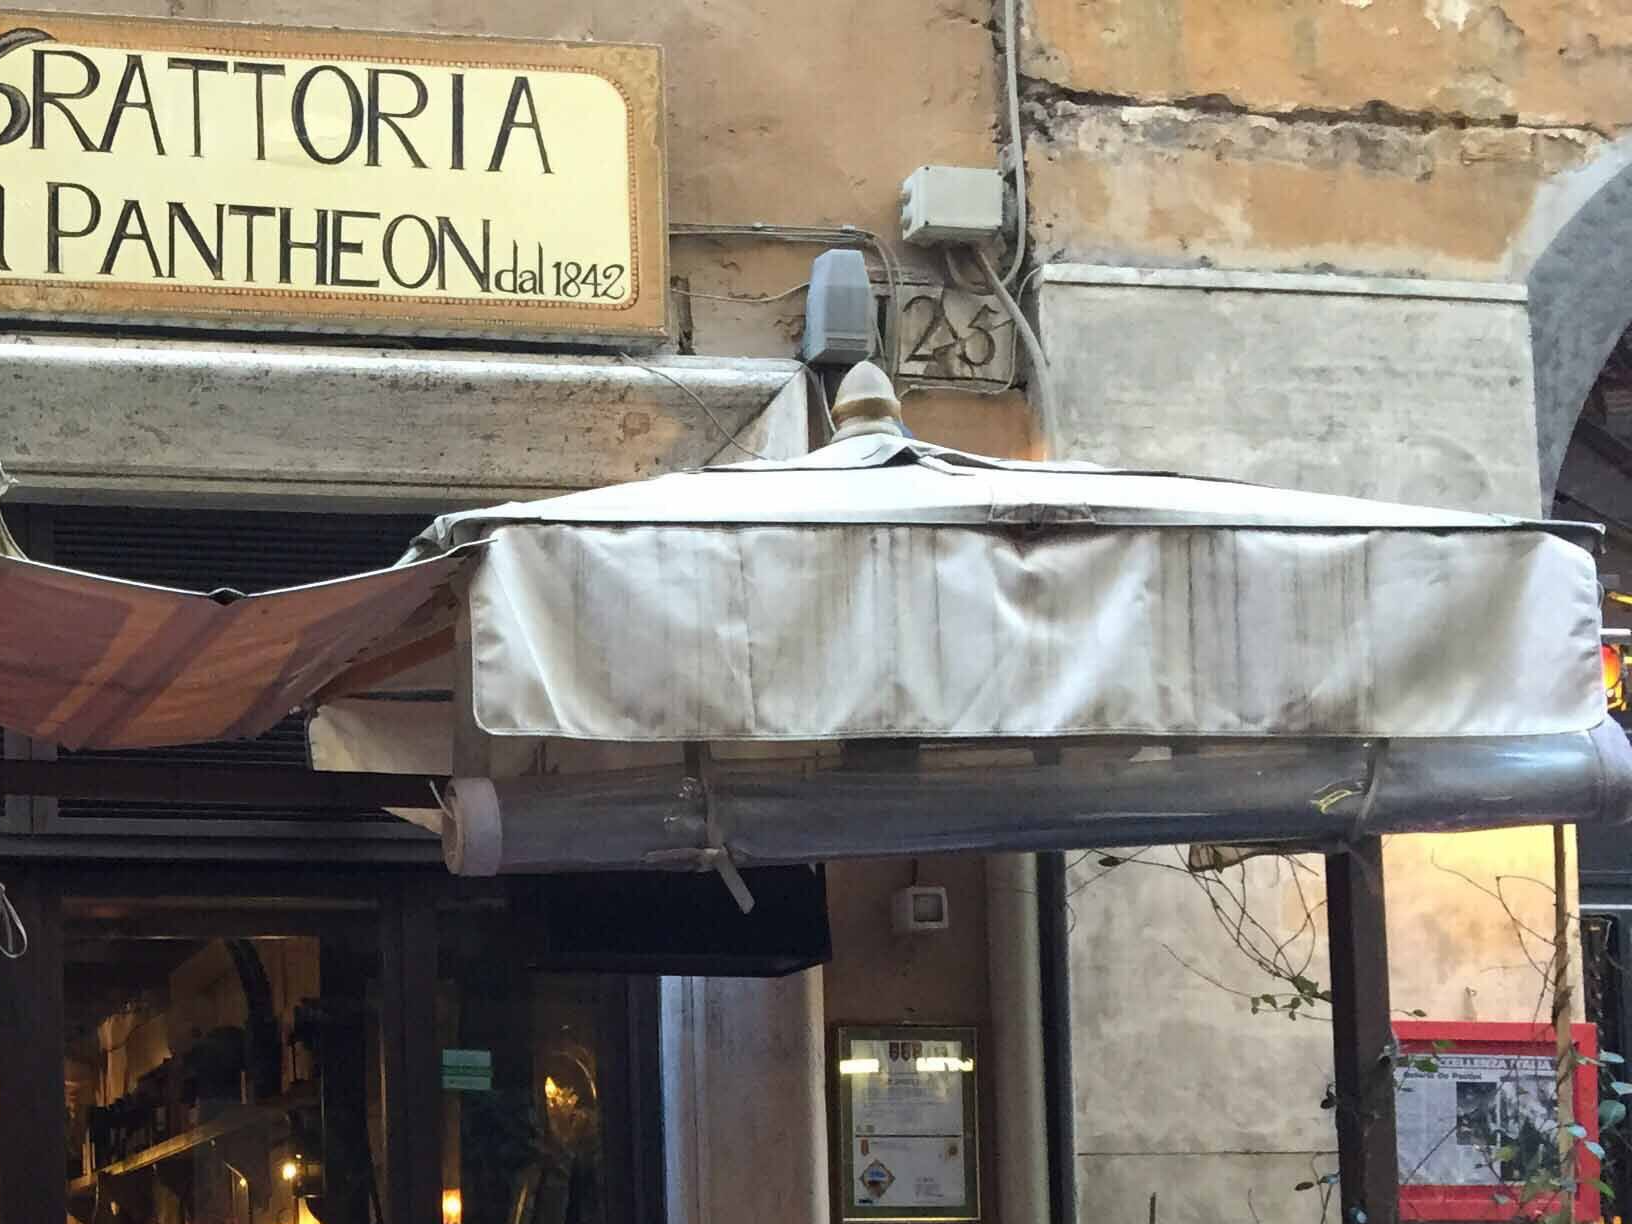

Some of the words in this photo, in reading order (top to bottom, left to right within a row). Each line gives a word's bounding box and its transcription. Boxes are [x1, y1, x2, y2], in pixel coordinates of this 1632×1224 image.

[47, 181, 494, 294] PANTHEON
[495, 240, 544, 295] dal
[552, 261, 626, 298] 1842
